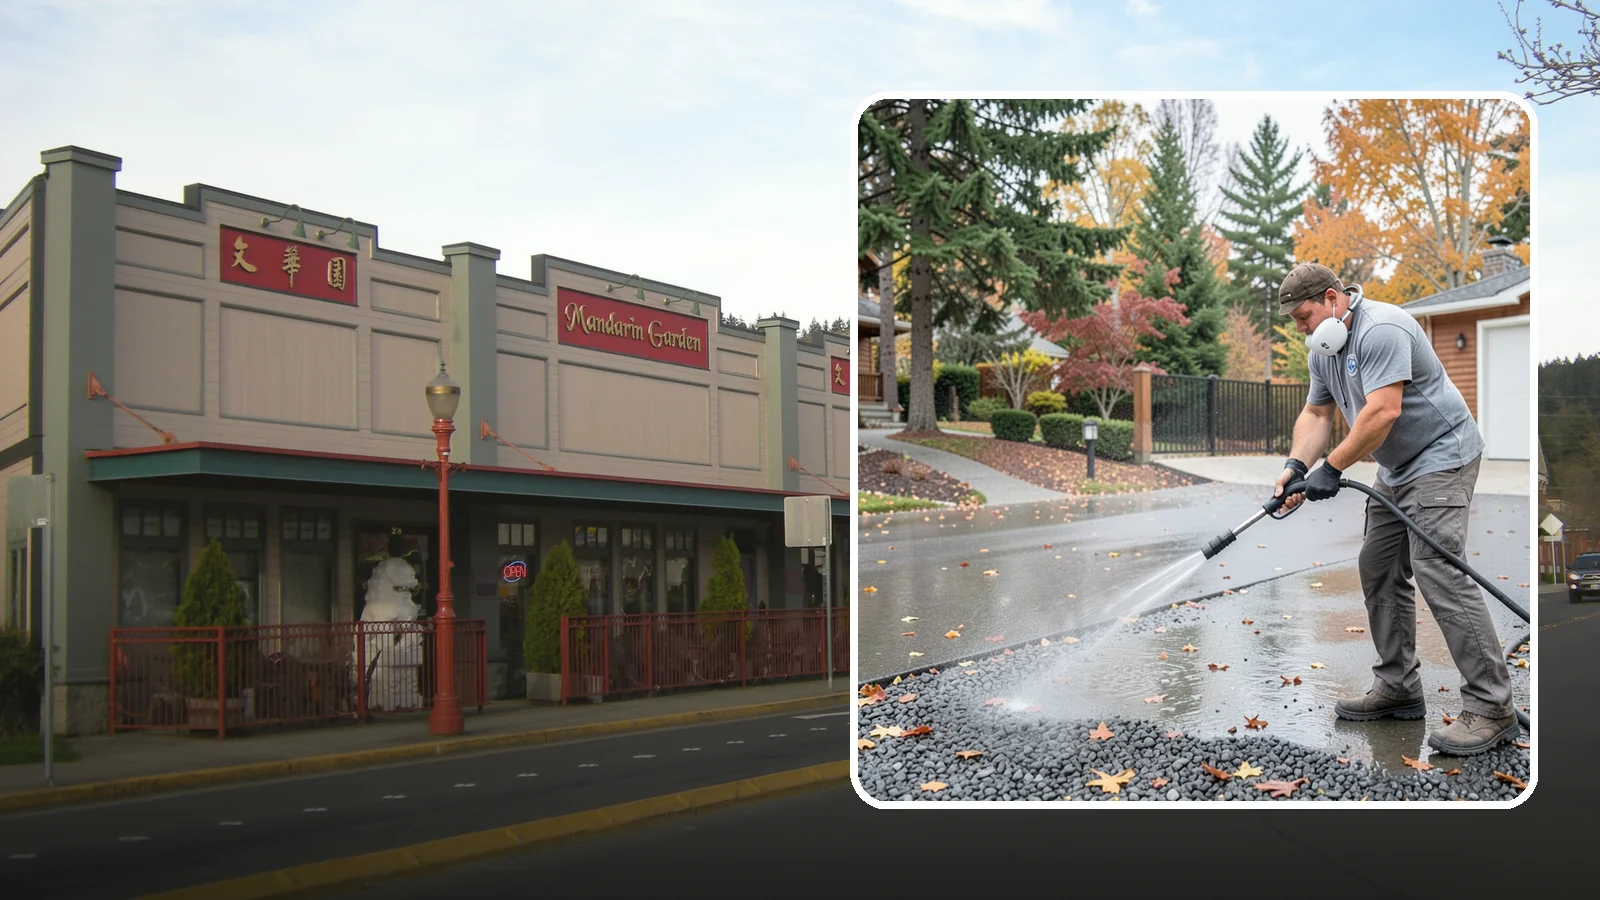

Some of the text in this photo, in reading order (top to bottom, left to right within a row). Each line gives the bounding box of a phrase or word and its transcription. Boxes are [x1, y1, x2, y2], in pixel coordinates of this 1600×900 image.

[230, 235, 347, 291] 文華園
[564, 301, 701, 352] Mandarin Garden
[503, 565, 527, 578] OPEN
